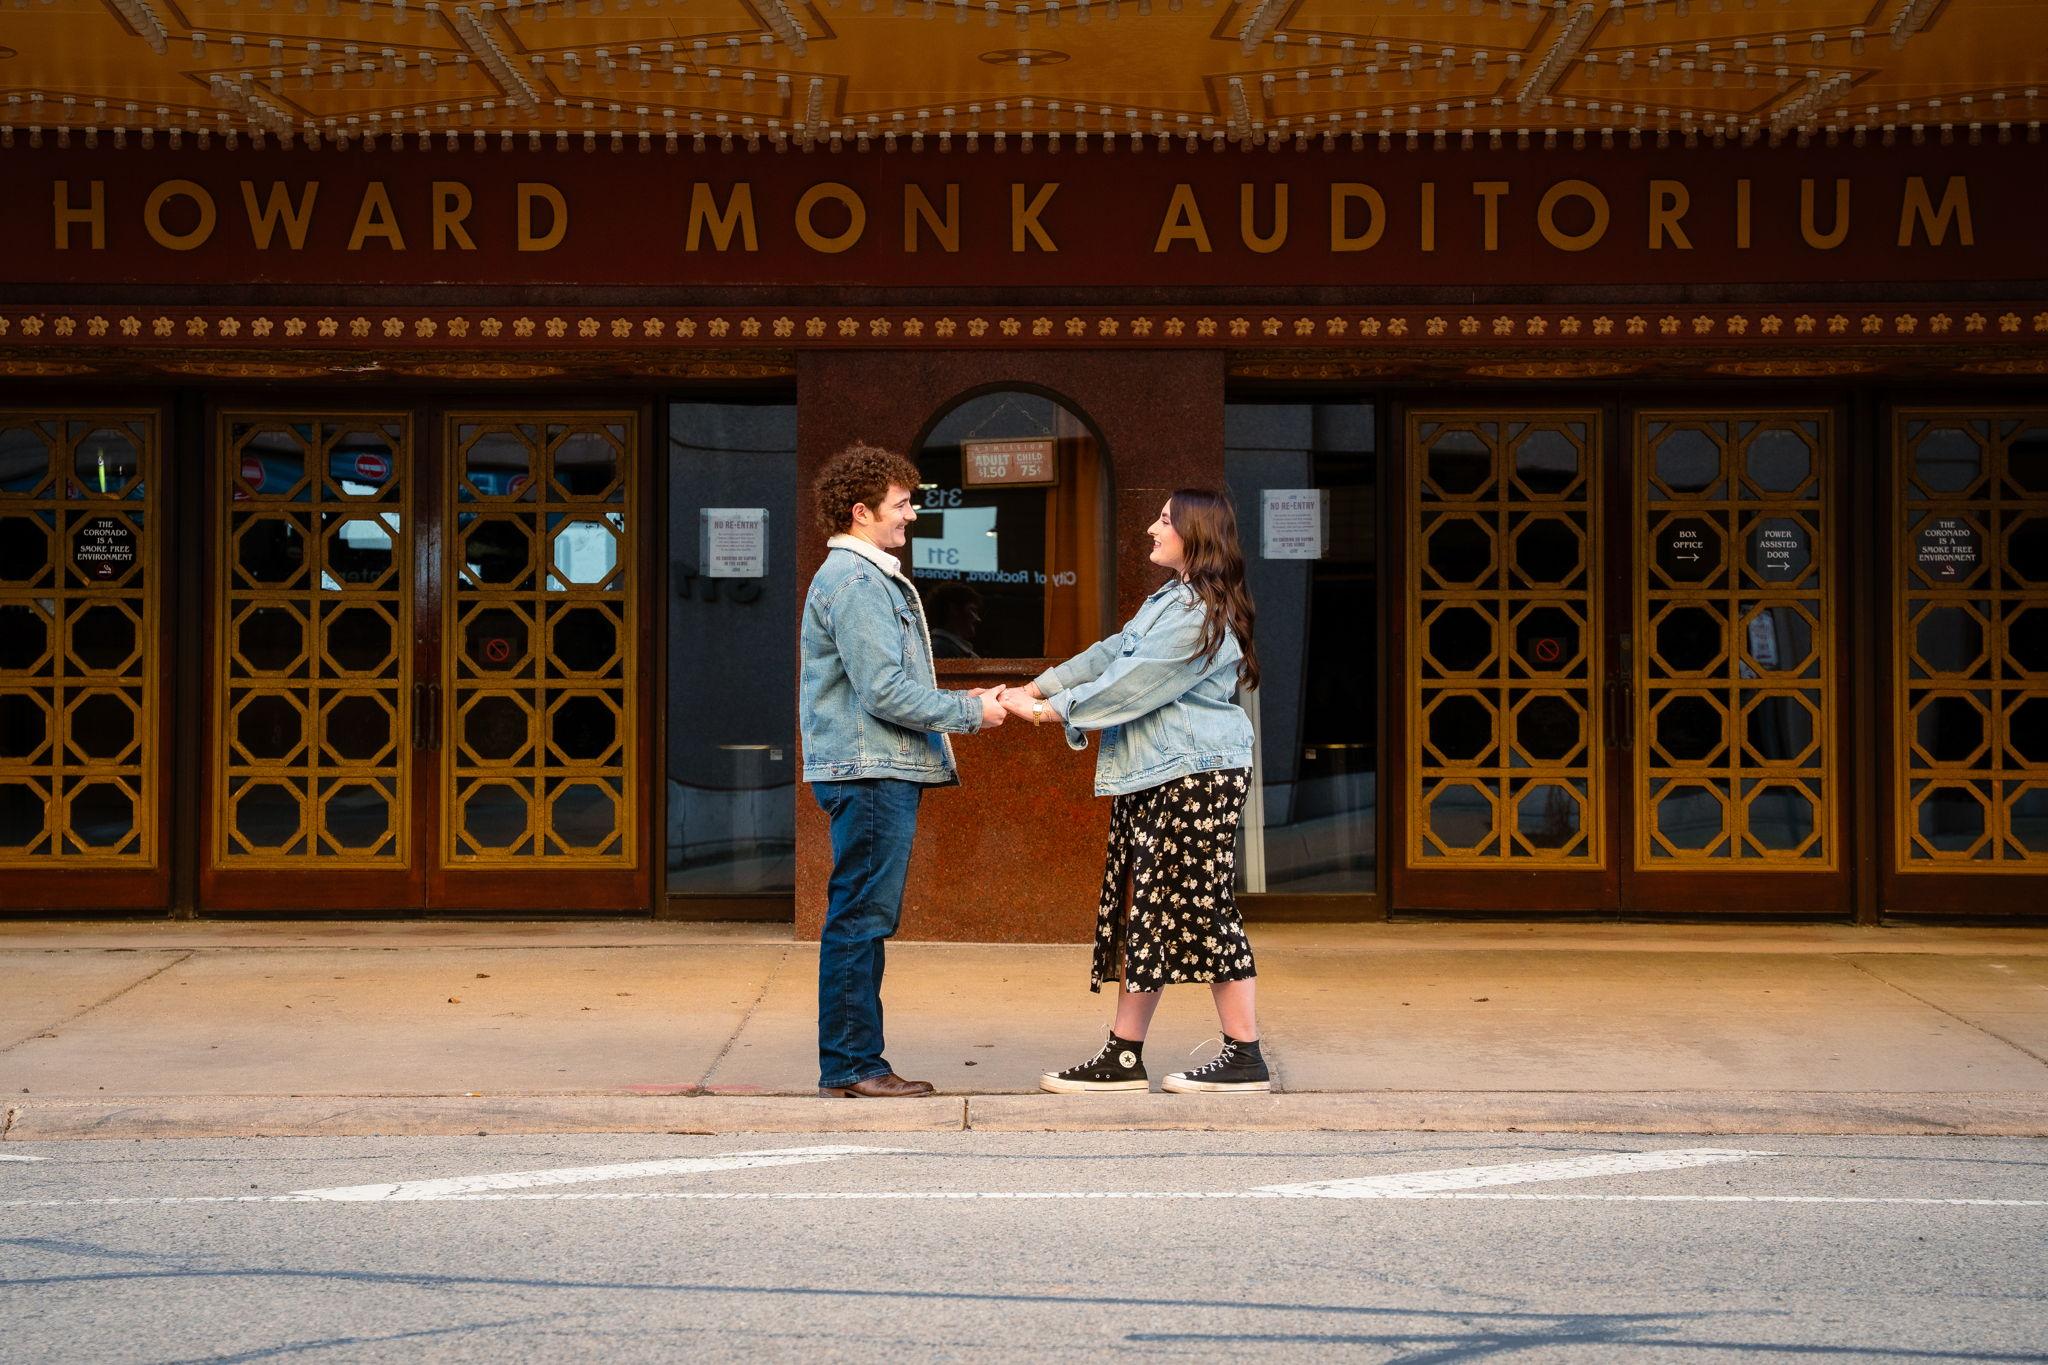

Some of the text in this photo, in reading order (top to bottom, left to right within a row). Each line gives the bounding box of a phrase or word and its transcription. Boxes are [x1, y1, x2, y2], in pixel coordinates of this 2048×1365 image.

[52, 176, 1976, 253] HOWARD MONK AUDITORIUM
[975, 454, 1010, 466] ADULT
[1016, 452, 1043, 461] CHILD
[978, 466, 1006, 478] $1.50
[1270, 501, 1315, 510] NO RE-ENTRY
[97, 520, 113, 528] THE
[714, 521, 759, 529] NO RE-ENTRY
[1938, 521, 1955, 529] THE
[83, 529, 128, 537] CORONADO
[1764, 530, 1793, 538] POWER
[1924, 529, 1971, 537] CORONADO
[80, 545, 130, 553] SMOKE FREE
[1672, 541, 1704, 549] OFFICE
[77, 553, 133, 561] ENVIRONMENT
[1766, 551, 1790, 559] DOOR
[1918, 554, 1976, 562] ENVIRONMENT
